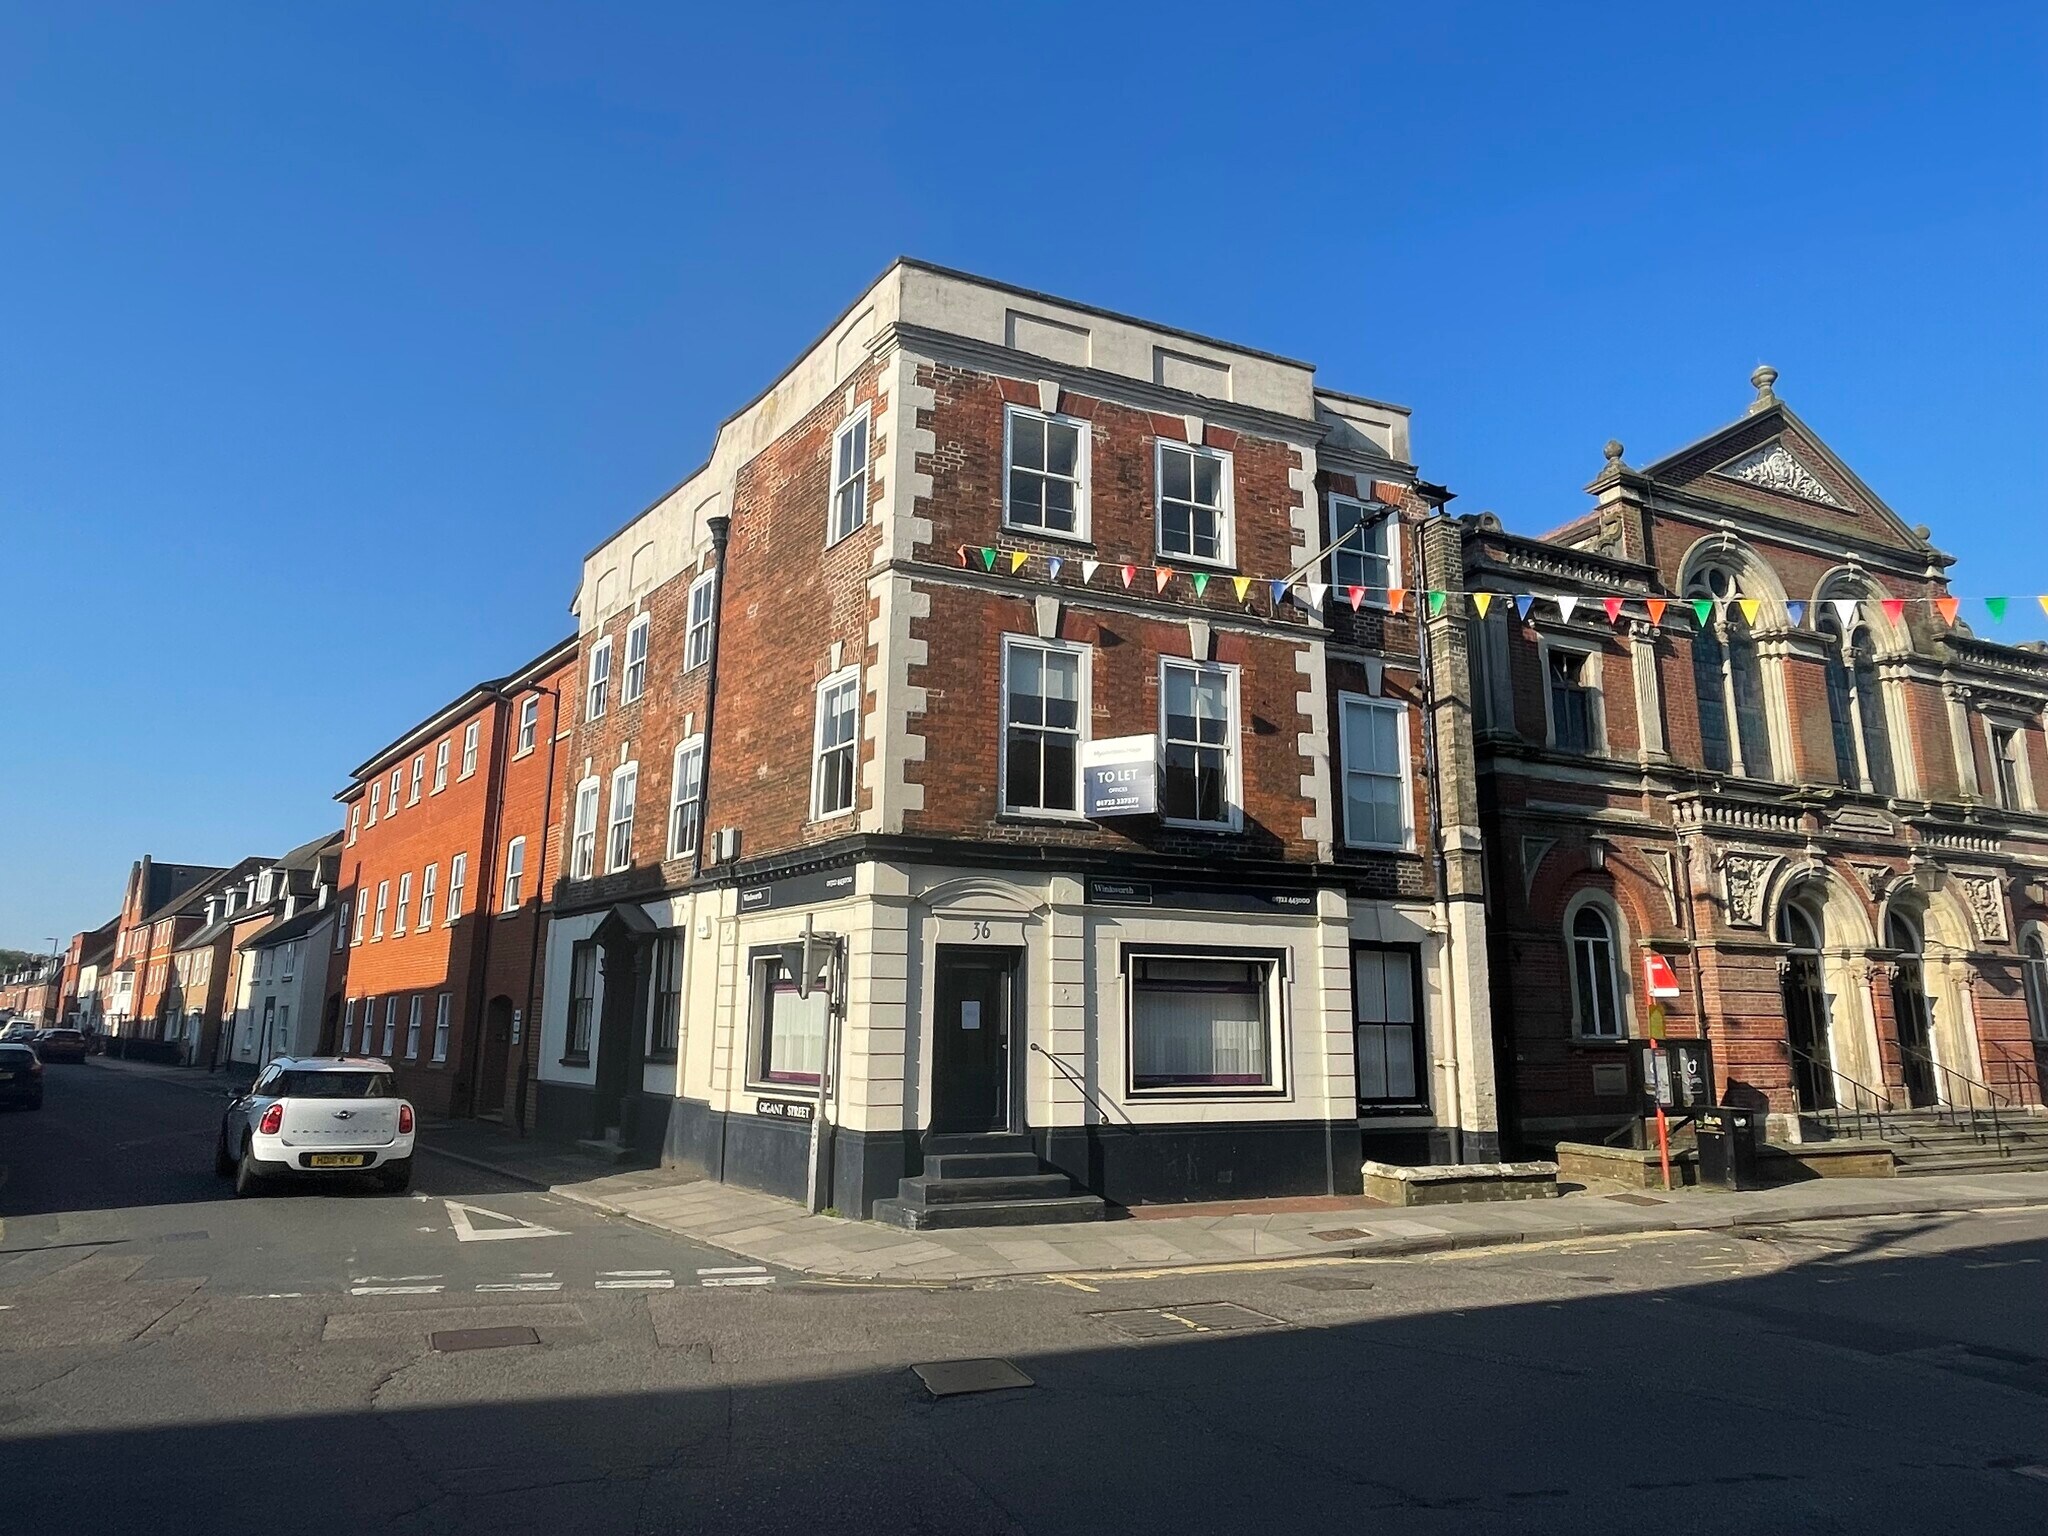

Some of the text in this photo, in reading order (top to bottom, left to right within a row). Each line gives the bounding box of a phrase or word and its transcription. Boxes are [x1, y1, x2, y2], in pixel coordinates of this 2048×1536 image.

[1097, 769, 1138, 783] TO LET
[972, 920, 991, 940] 36
[787, 1105, 811, 1118] STREET
